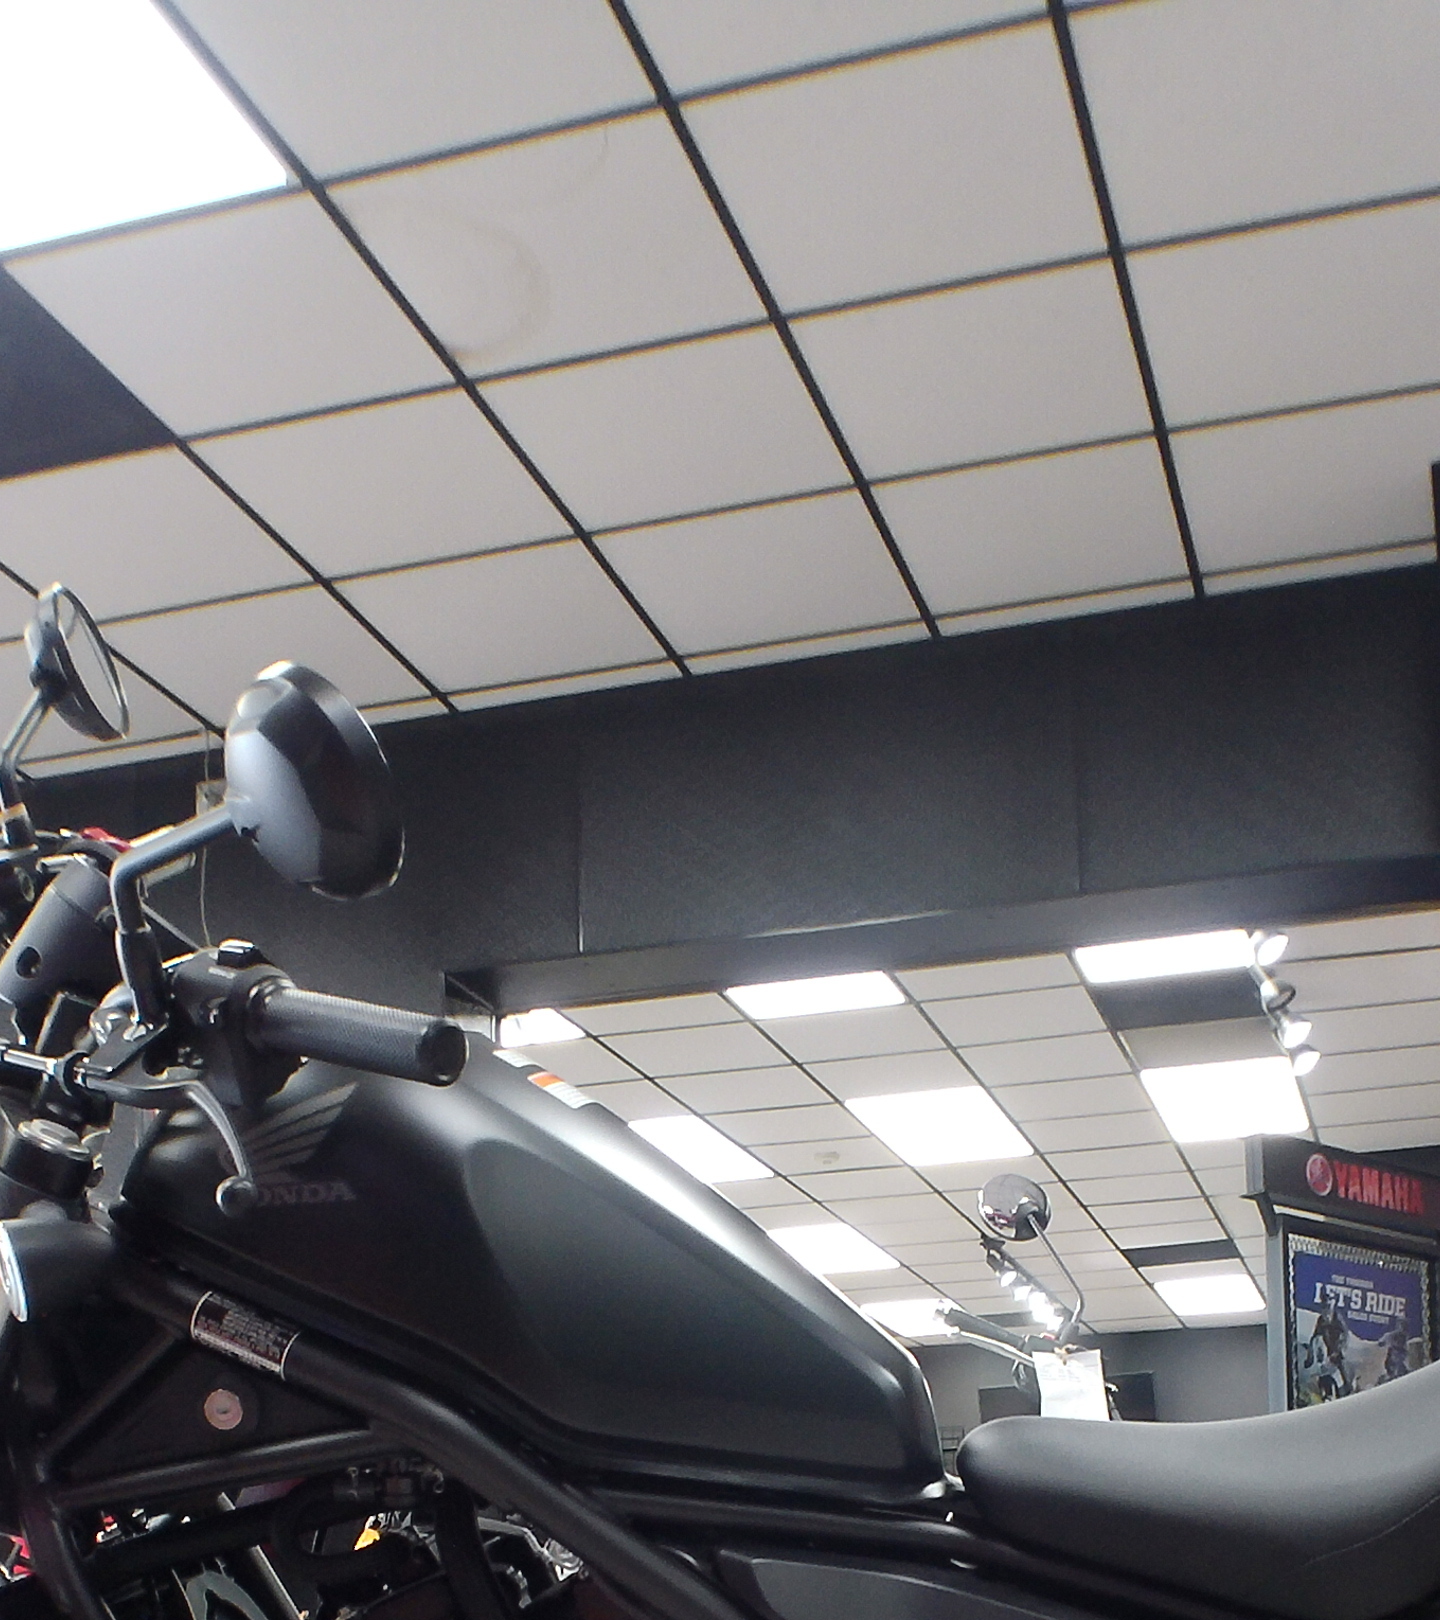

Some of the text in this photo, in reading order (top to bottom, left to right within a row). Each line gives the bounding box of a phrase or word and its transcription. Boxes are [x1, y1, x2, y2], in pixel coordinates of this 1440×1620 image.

[256, 1180, 357, 1207] ONDA
[1333, 1160, 1424, 1215] YAMAHA
[1364, 1291, 1406, 1318] RIDE
